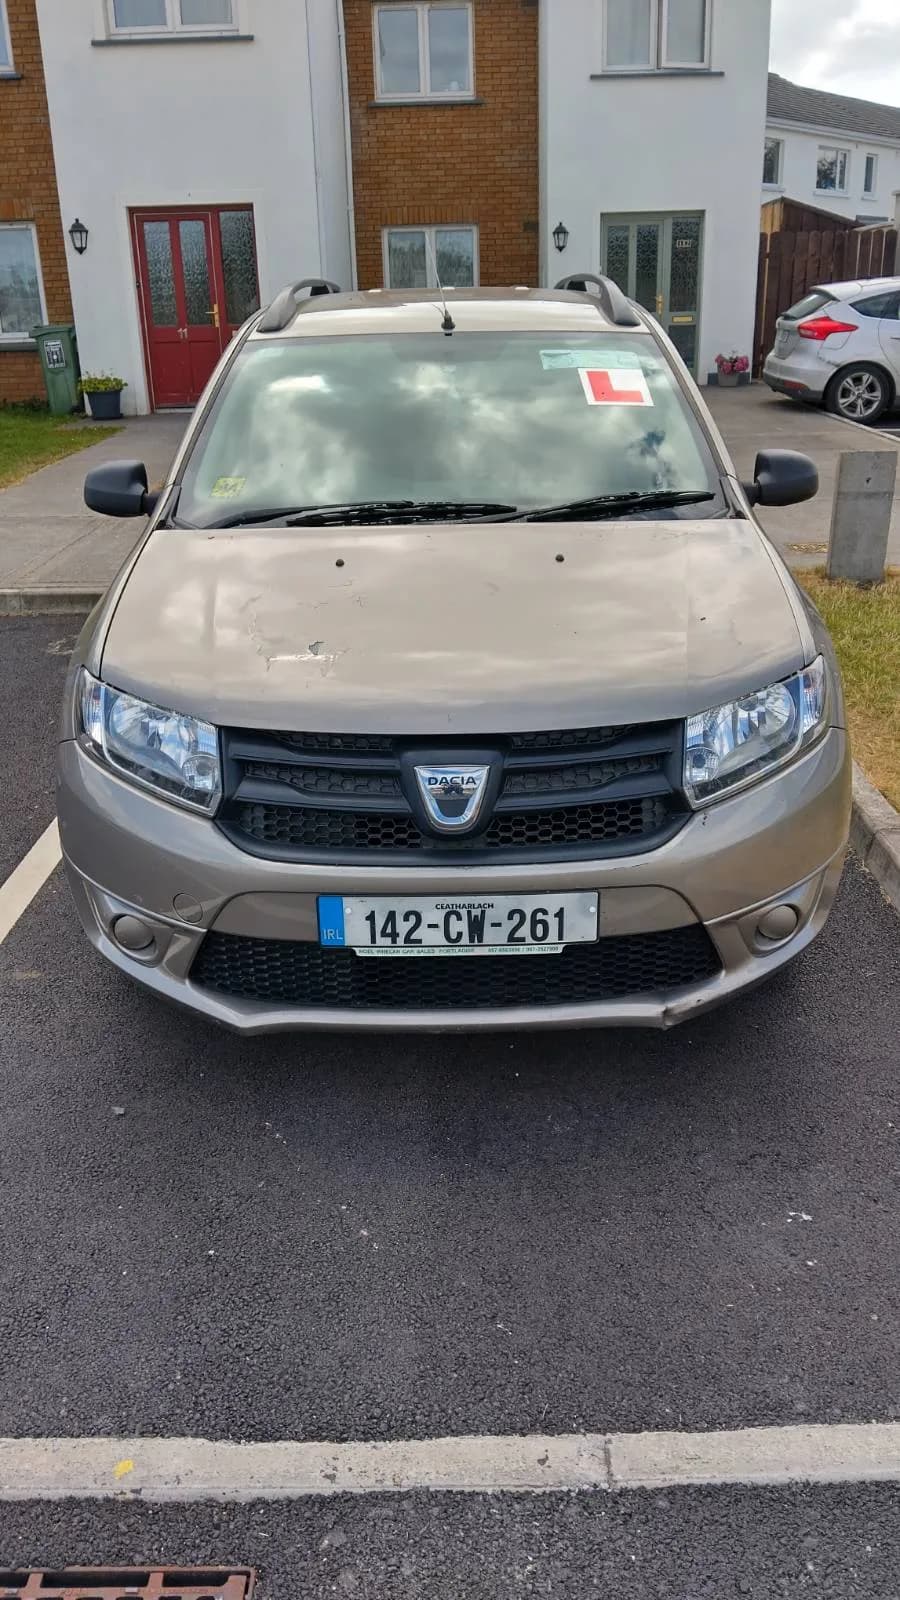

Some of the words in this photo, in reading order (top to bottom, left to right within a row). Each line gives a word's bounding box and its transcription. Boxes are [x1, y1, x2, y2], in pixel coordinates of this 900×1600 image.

[586, 371, 644, 402] L
[428, 776, 476, 786] DACIA
[323, 928, 344, 940] IRL
[364, 907, 565, 945] 142-CW-261
